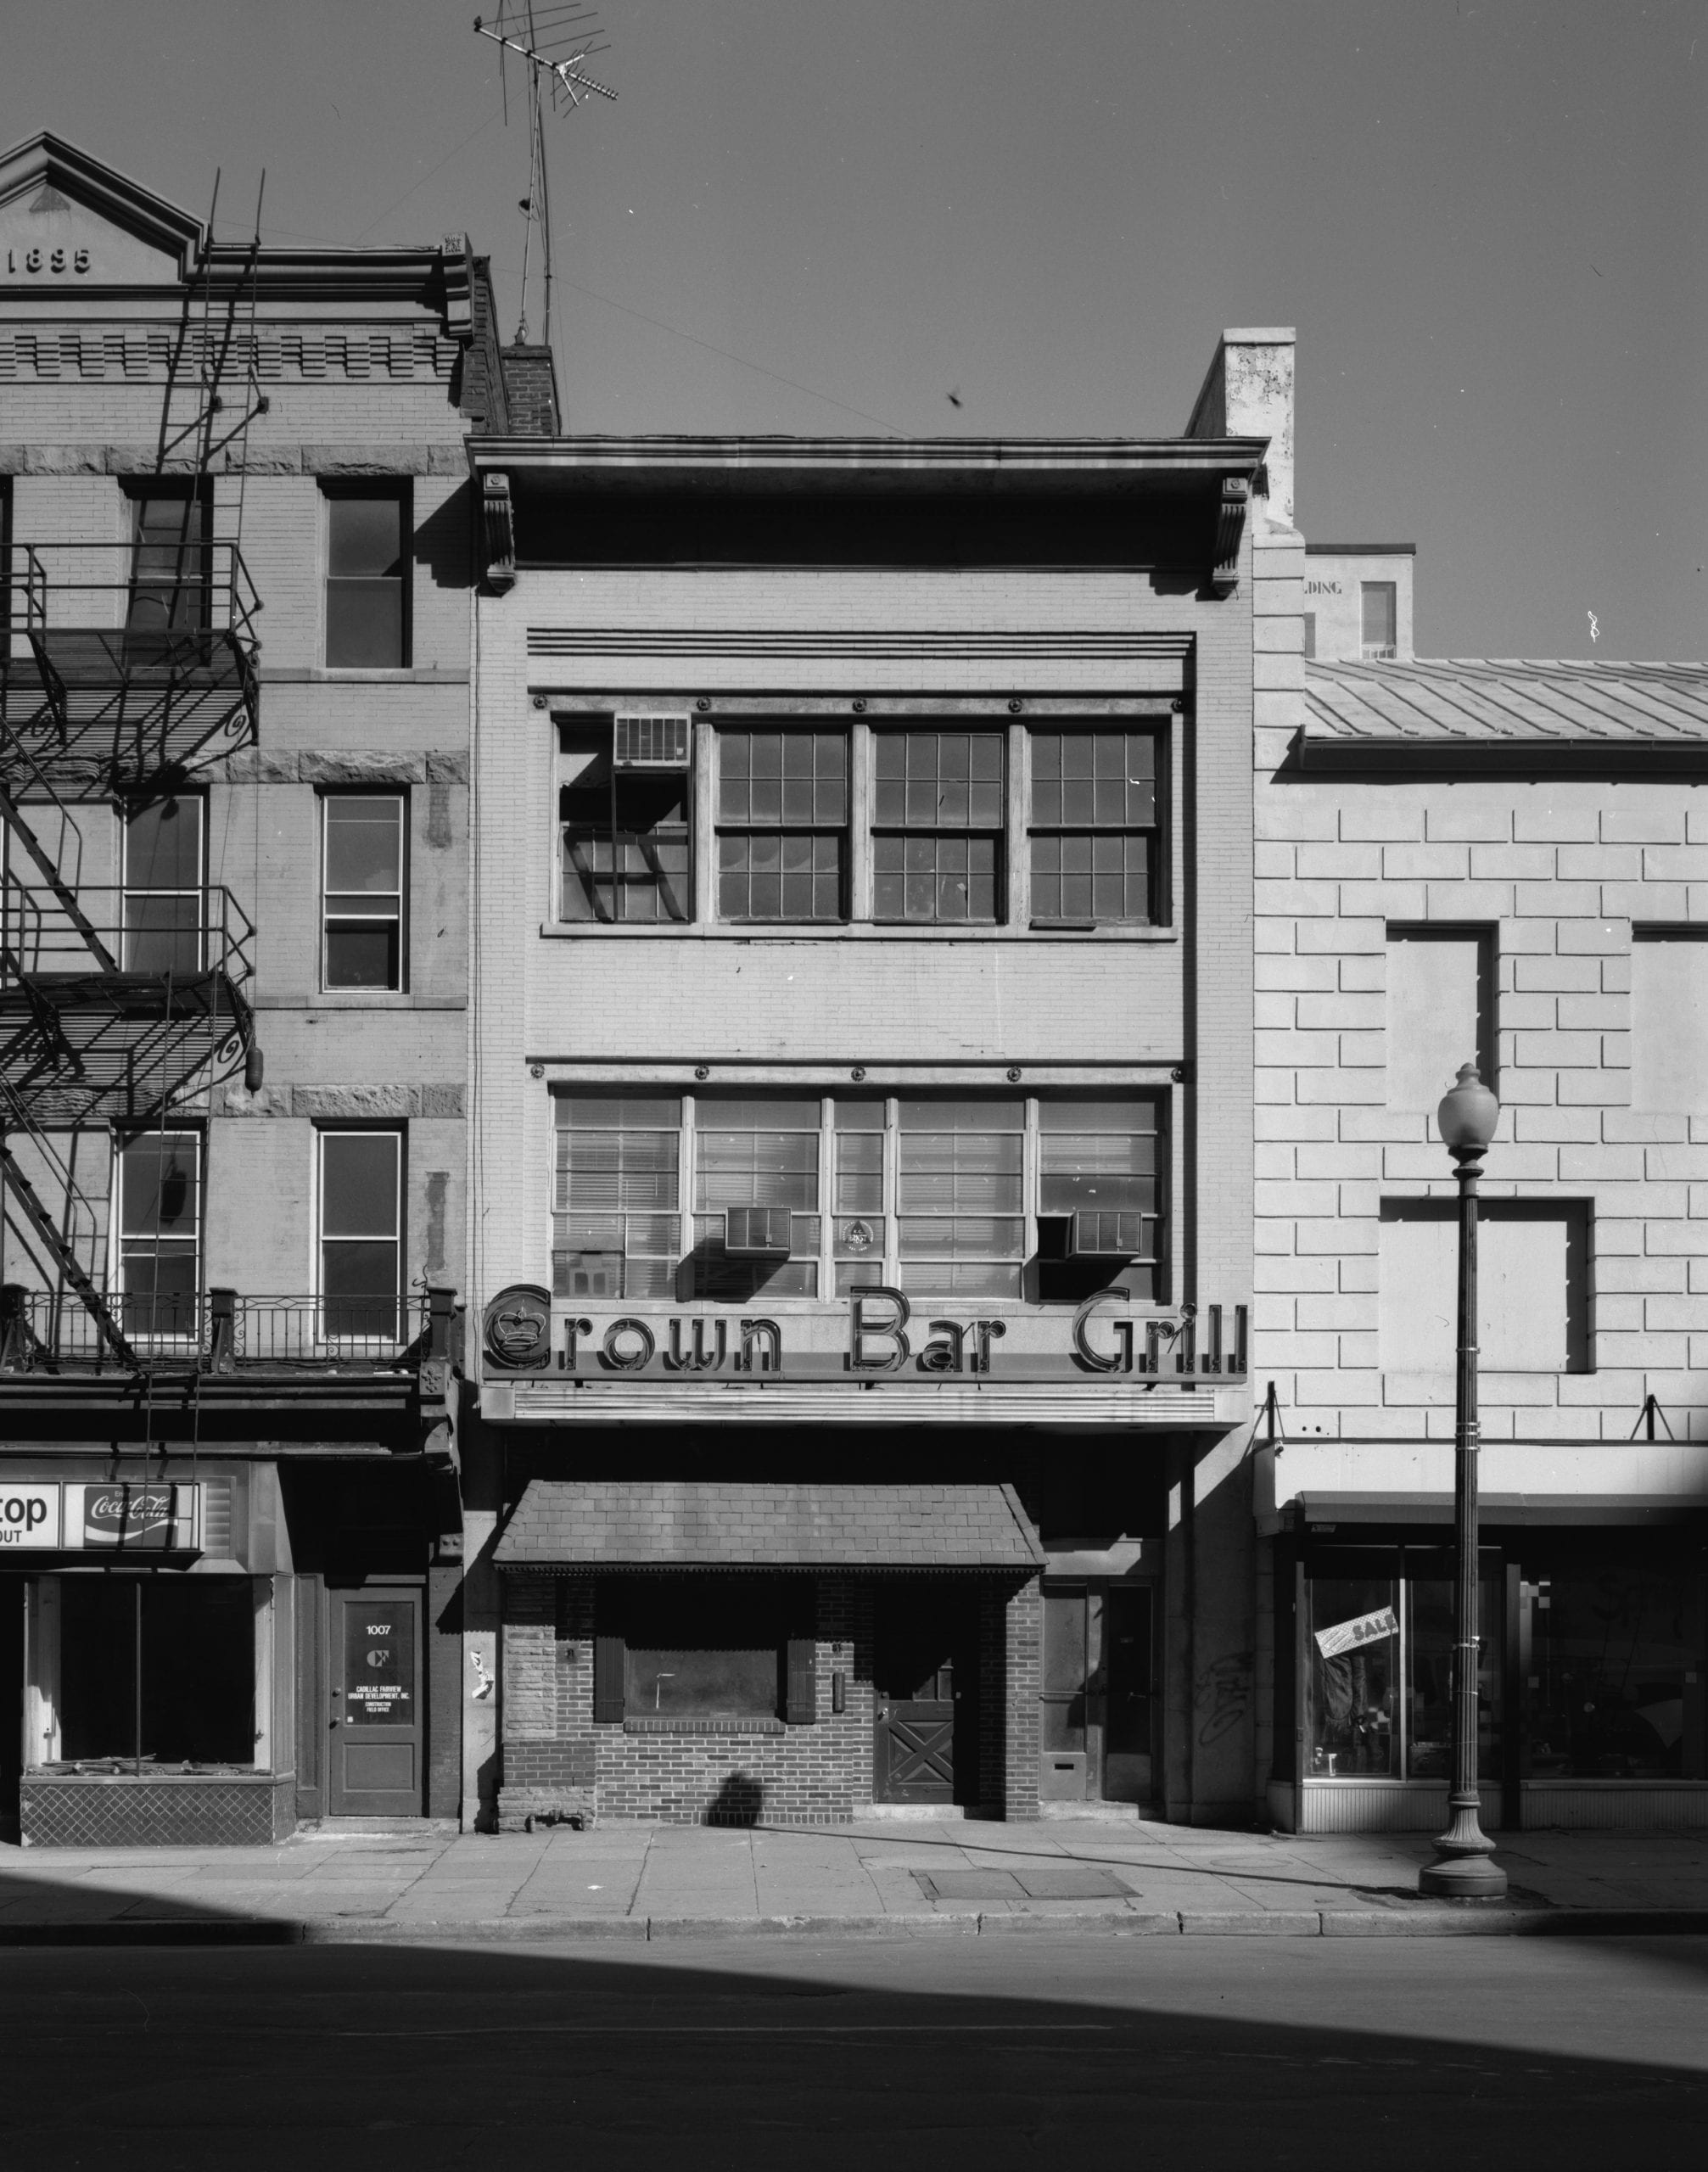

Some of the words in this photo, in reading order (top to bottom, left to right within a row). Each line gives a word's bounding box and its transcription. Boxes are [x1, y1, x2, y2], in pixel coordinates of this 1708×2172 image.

[8, 248, 91, 274] 1895
[483, 1284, 781, 1371] Crown
[850, 1286, 1005, 1373] Bar
[1072, 1287, 1247, 1374] Grill
[366, 1625, 391, 1635] 1007
[1352, 1613, 1397, 1641] SALE
